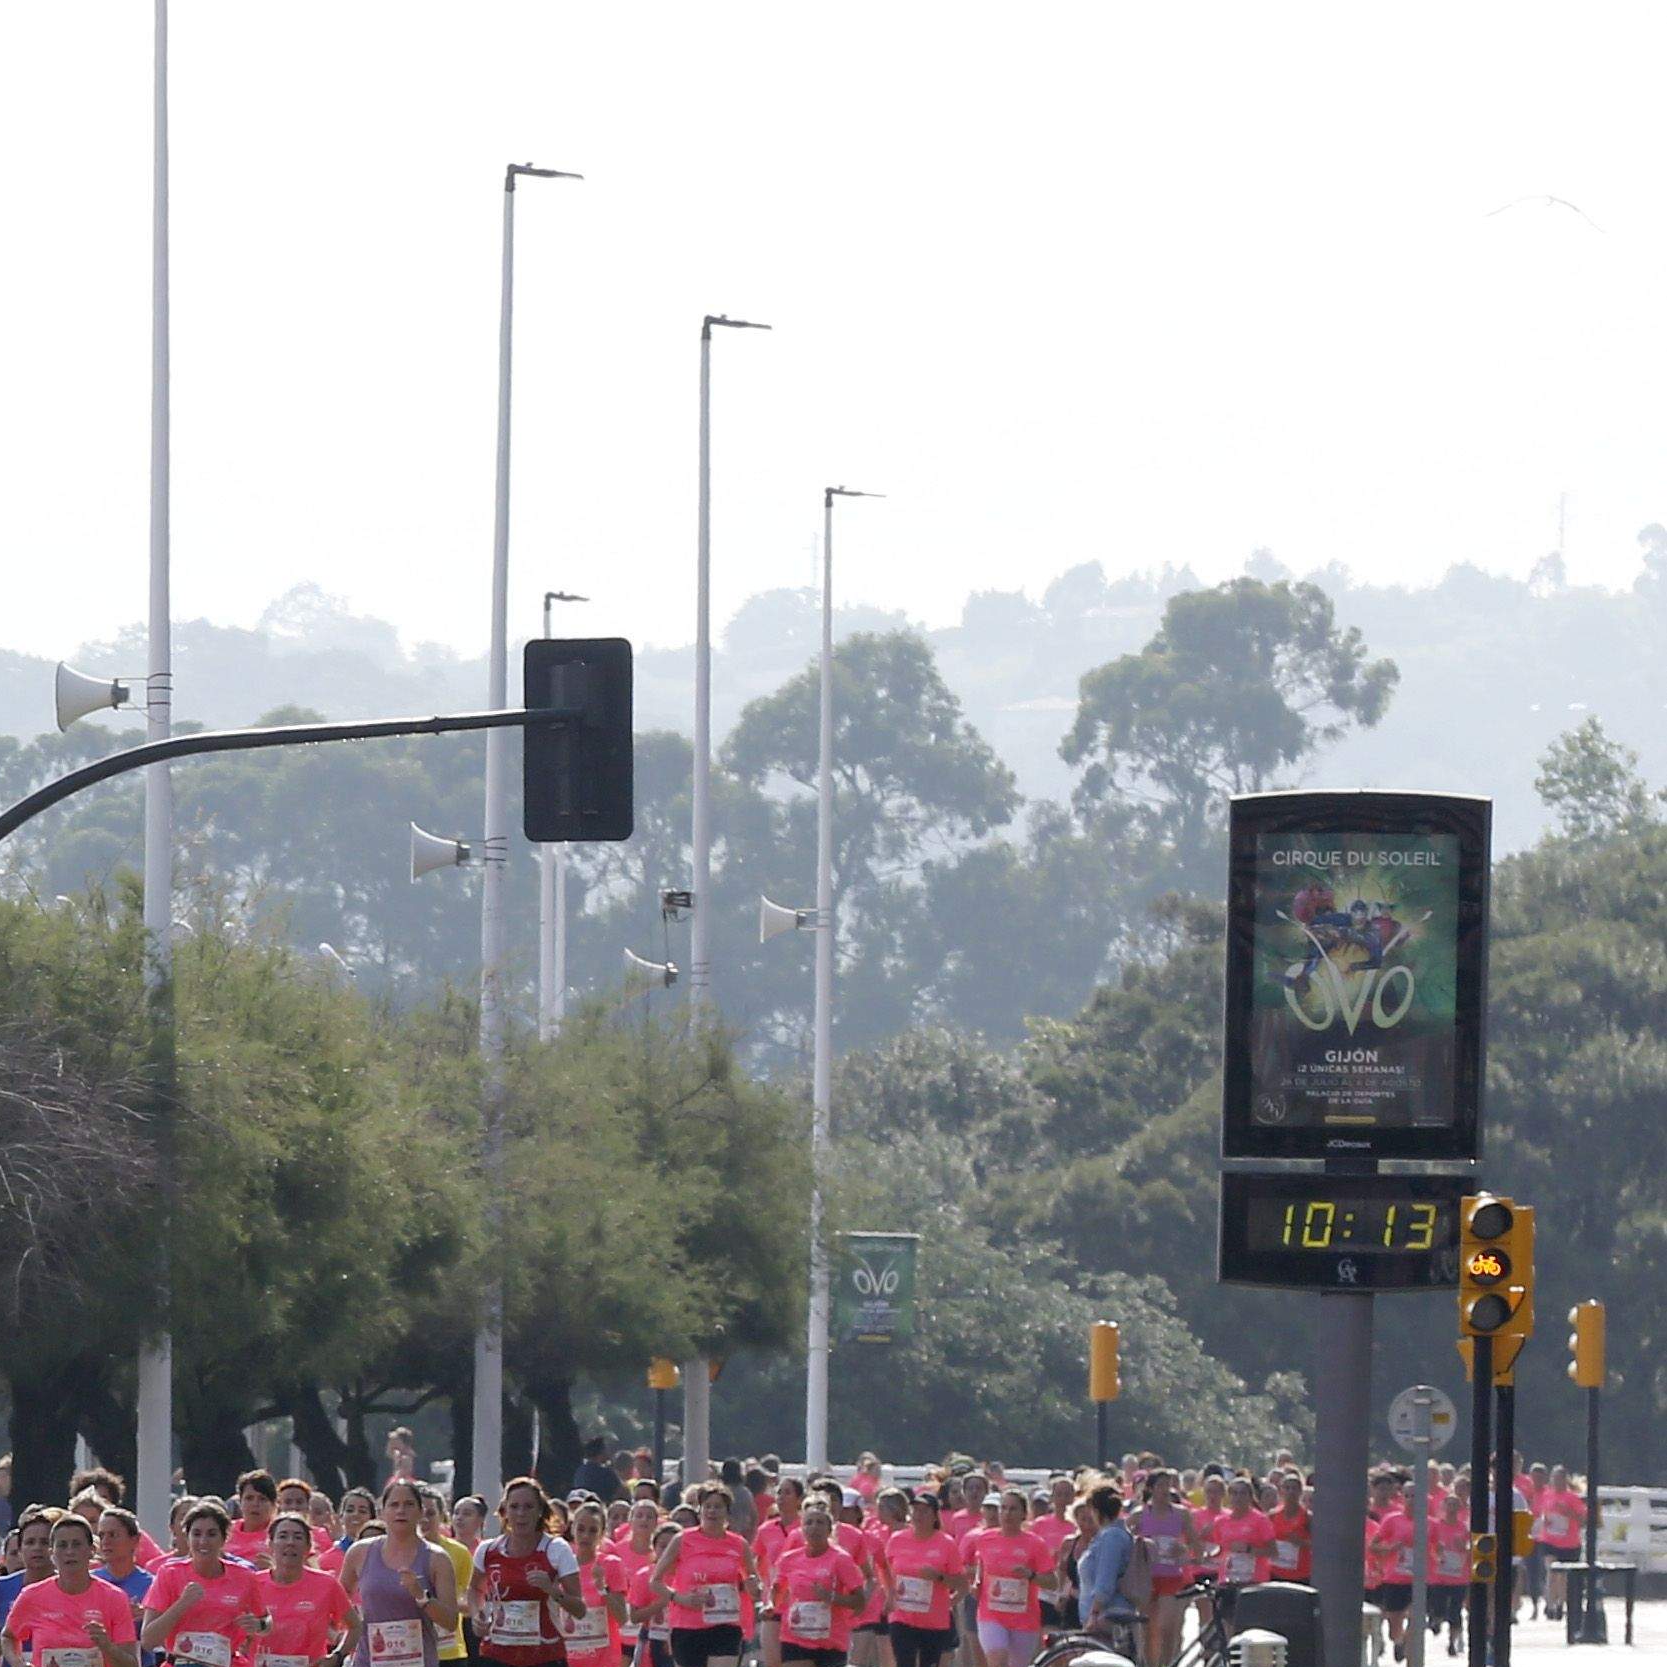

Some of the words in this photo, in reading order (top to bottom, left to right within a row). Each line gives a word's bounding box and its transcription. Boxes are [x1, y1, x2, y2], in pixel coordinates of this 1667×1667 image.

[1272, 850, 1341, 870] CIRQUE
[1347, 851, 1372, 866] DU
[1377, 850, 1441, 866] SOLEIL
[1325, 1048, 1379, 1063] GIJÓN
[1281, 1202, 1437, 1249] 10:13
[852, 1260, 901, 1296] OVO
